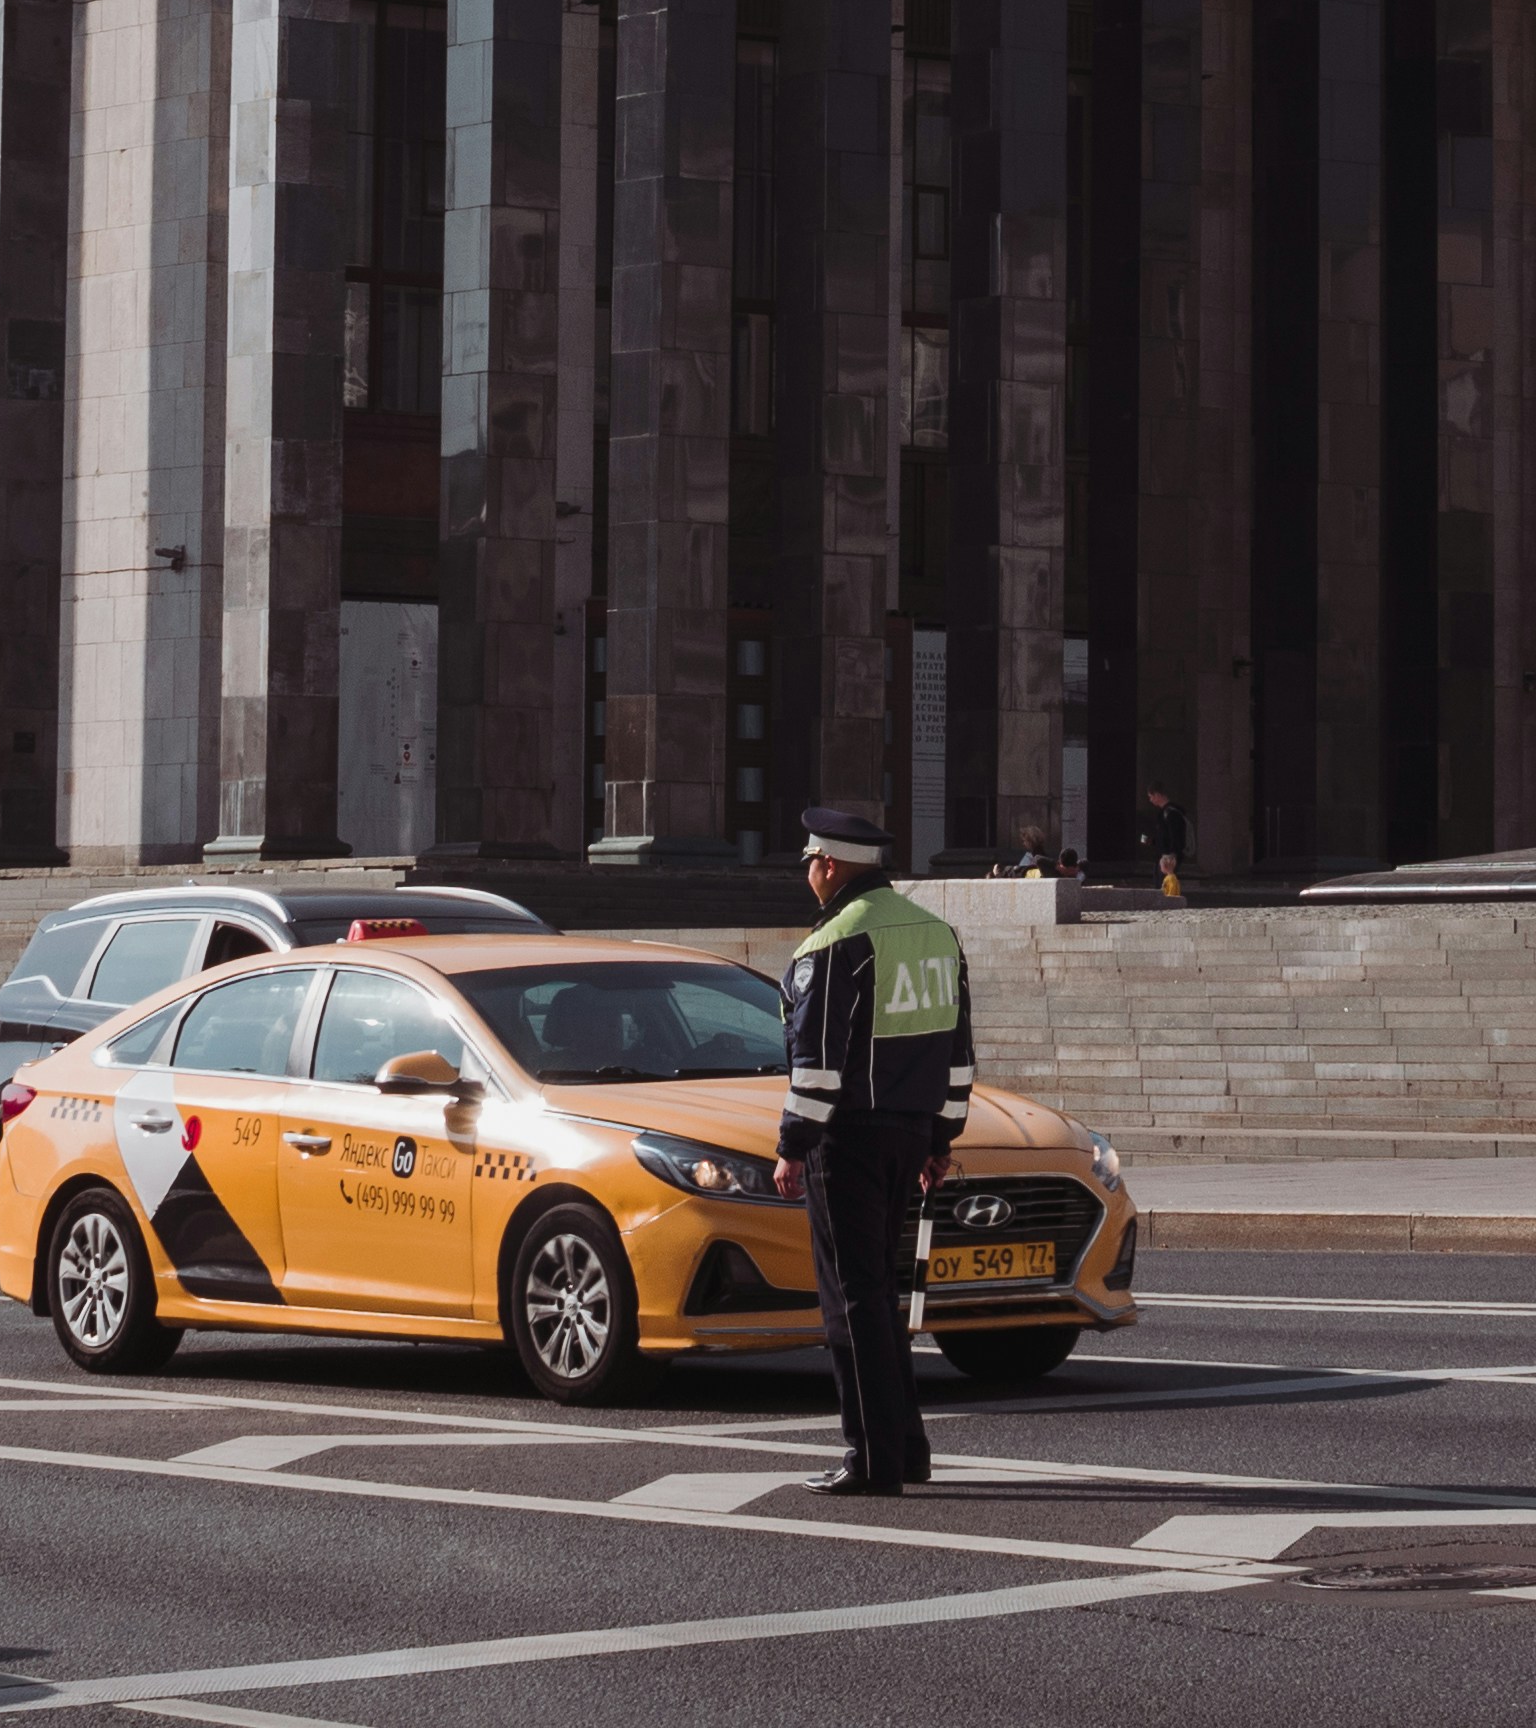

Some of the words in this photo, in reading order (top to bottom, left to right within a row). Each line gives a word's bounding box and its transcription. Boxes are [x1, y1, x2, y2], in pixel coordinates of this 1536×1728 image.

[233, 1117, 262, 1147] 549
[340, 1133, 389, 1169] Яндекс
[394, 1141, 413, 1173] Go
[421, 1145, 457, 1180] Такси
[357, 1182, 389, 1215] (495)
[392, 1190, 415, 1216] 999
[420, 1195, 435, 1219] 99
[440, 1199, 455, 1224] 99
[973, 1247, 1013, 1276] 549
[1027, 1244, 1048, 1265] 77
